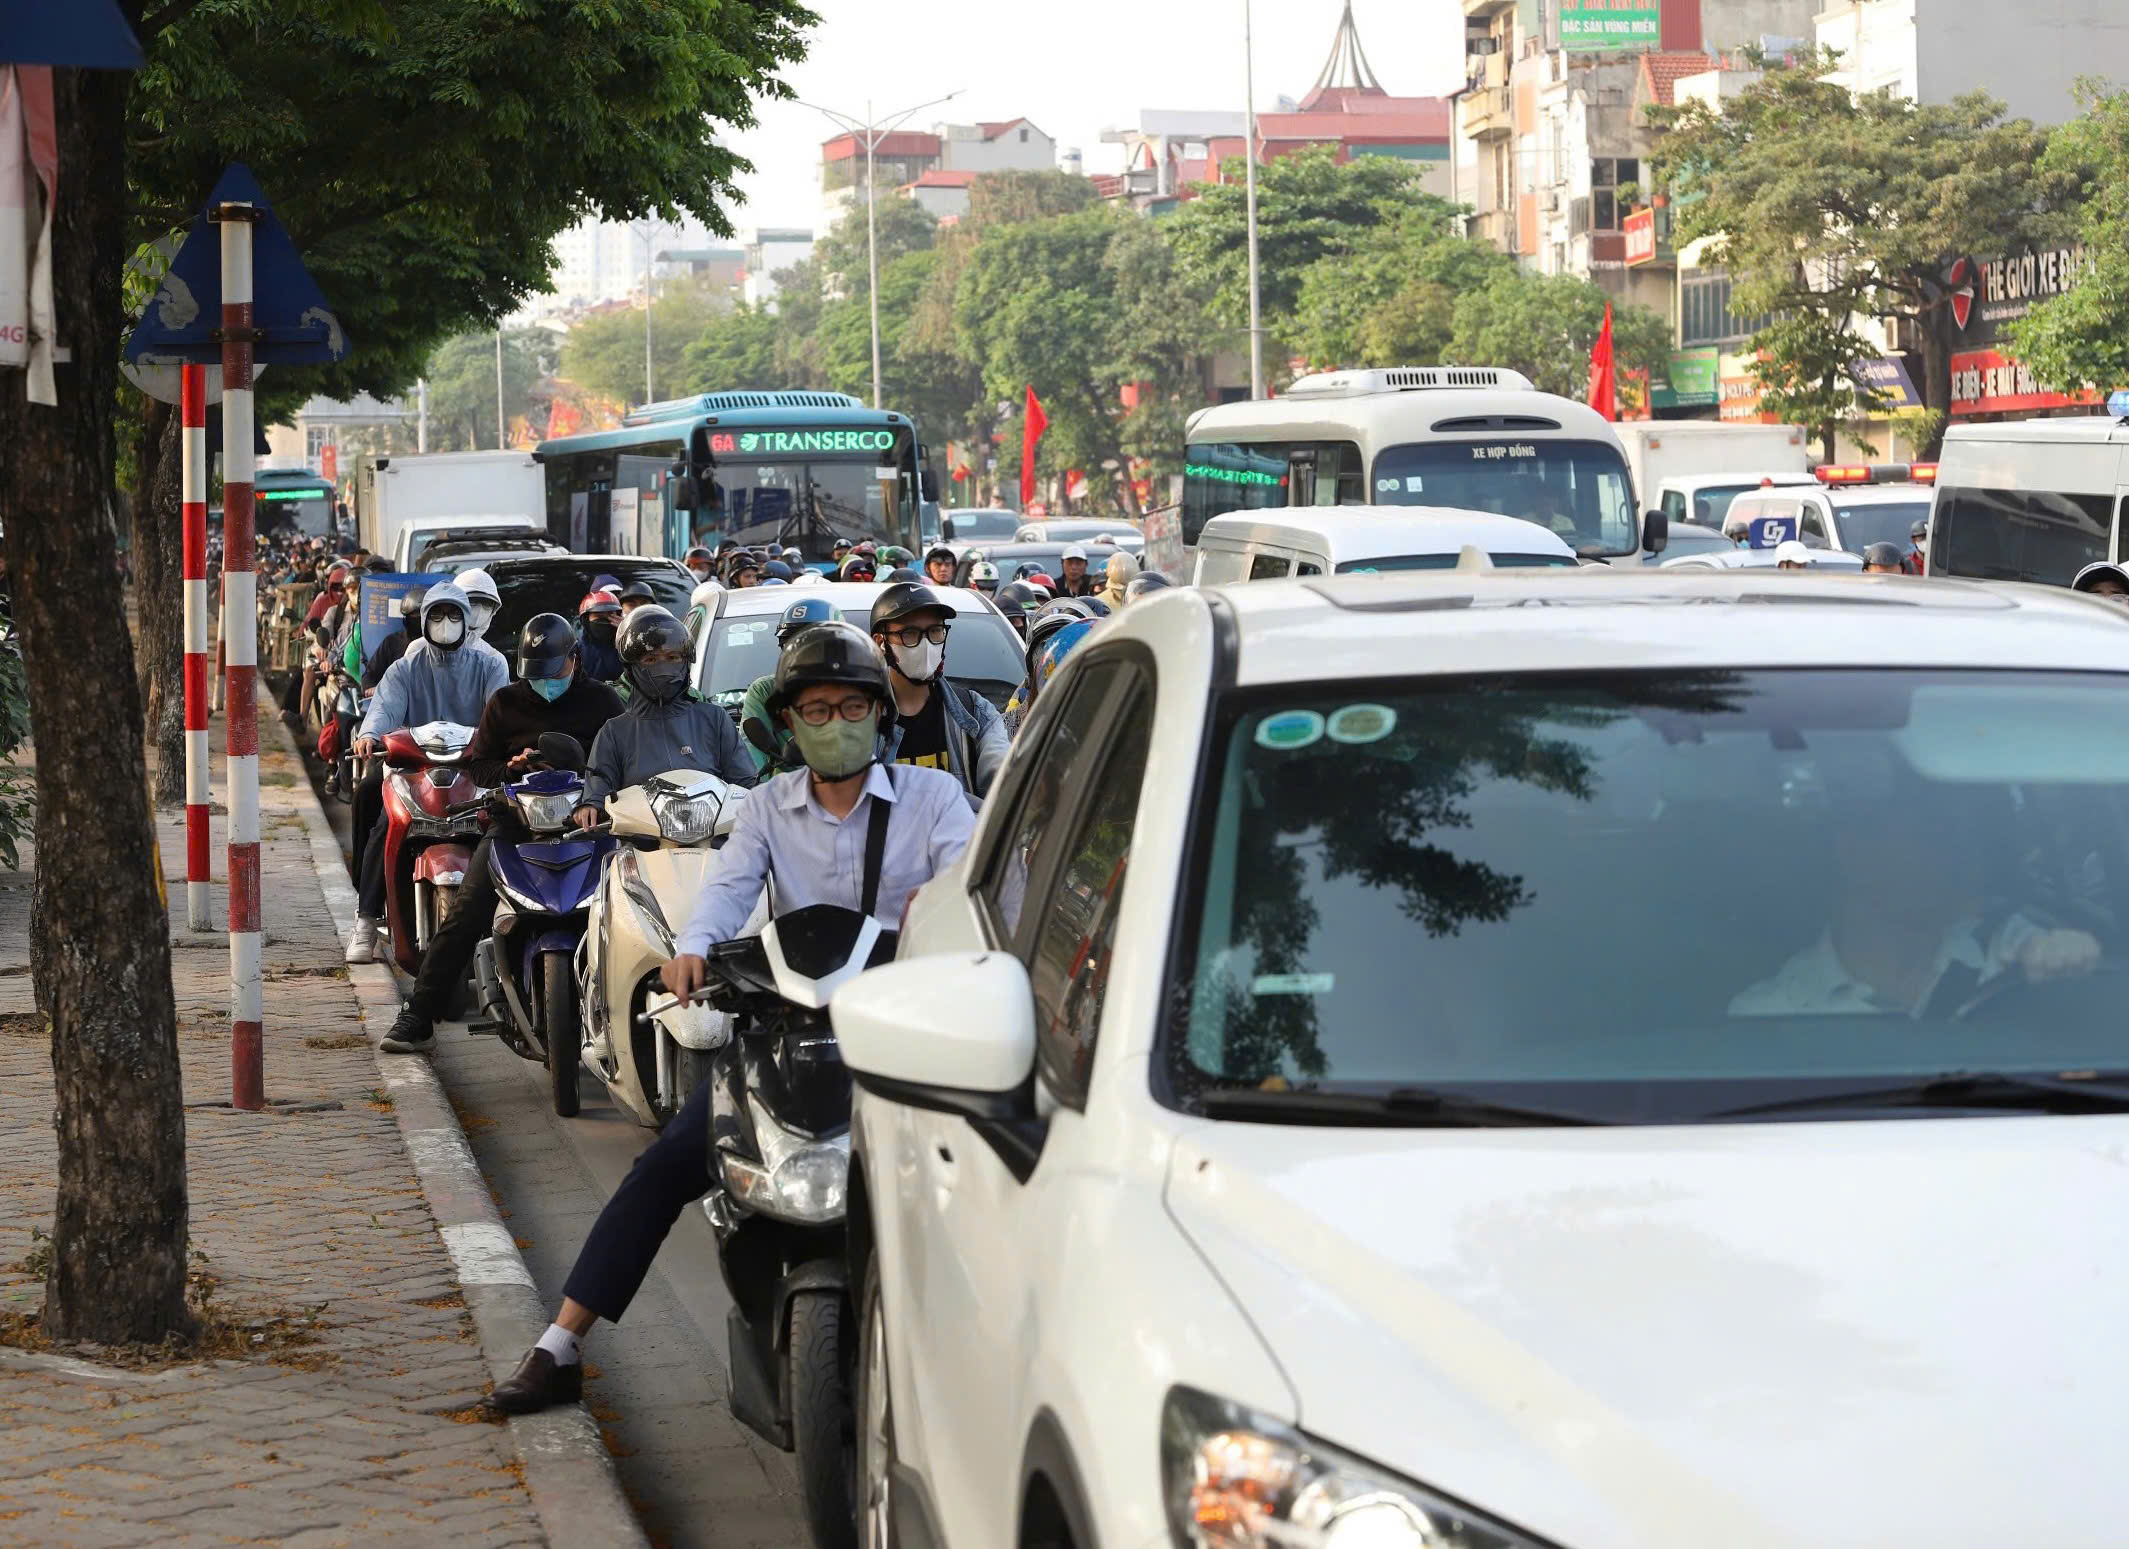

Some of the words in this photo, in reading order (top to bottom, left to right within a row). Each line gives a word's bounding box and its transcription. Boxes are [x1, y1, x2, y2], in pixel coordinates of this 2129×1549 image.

[2038, 252, 2058, 296] XE
[1986, 367, 1997, 398] XE
[711, 433, 735, 451] 6A
[761, 431, 894, 451] TRANSERCO
[1472, 447, 1486, 459] XE
[1488, 446, 1506, 460] HỢP
[1509, 443, 1536, 458] ĐỒNG
